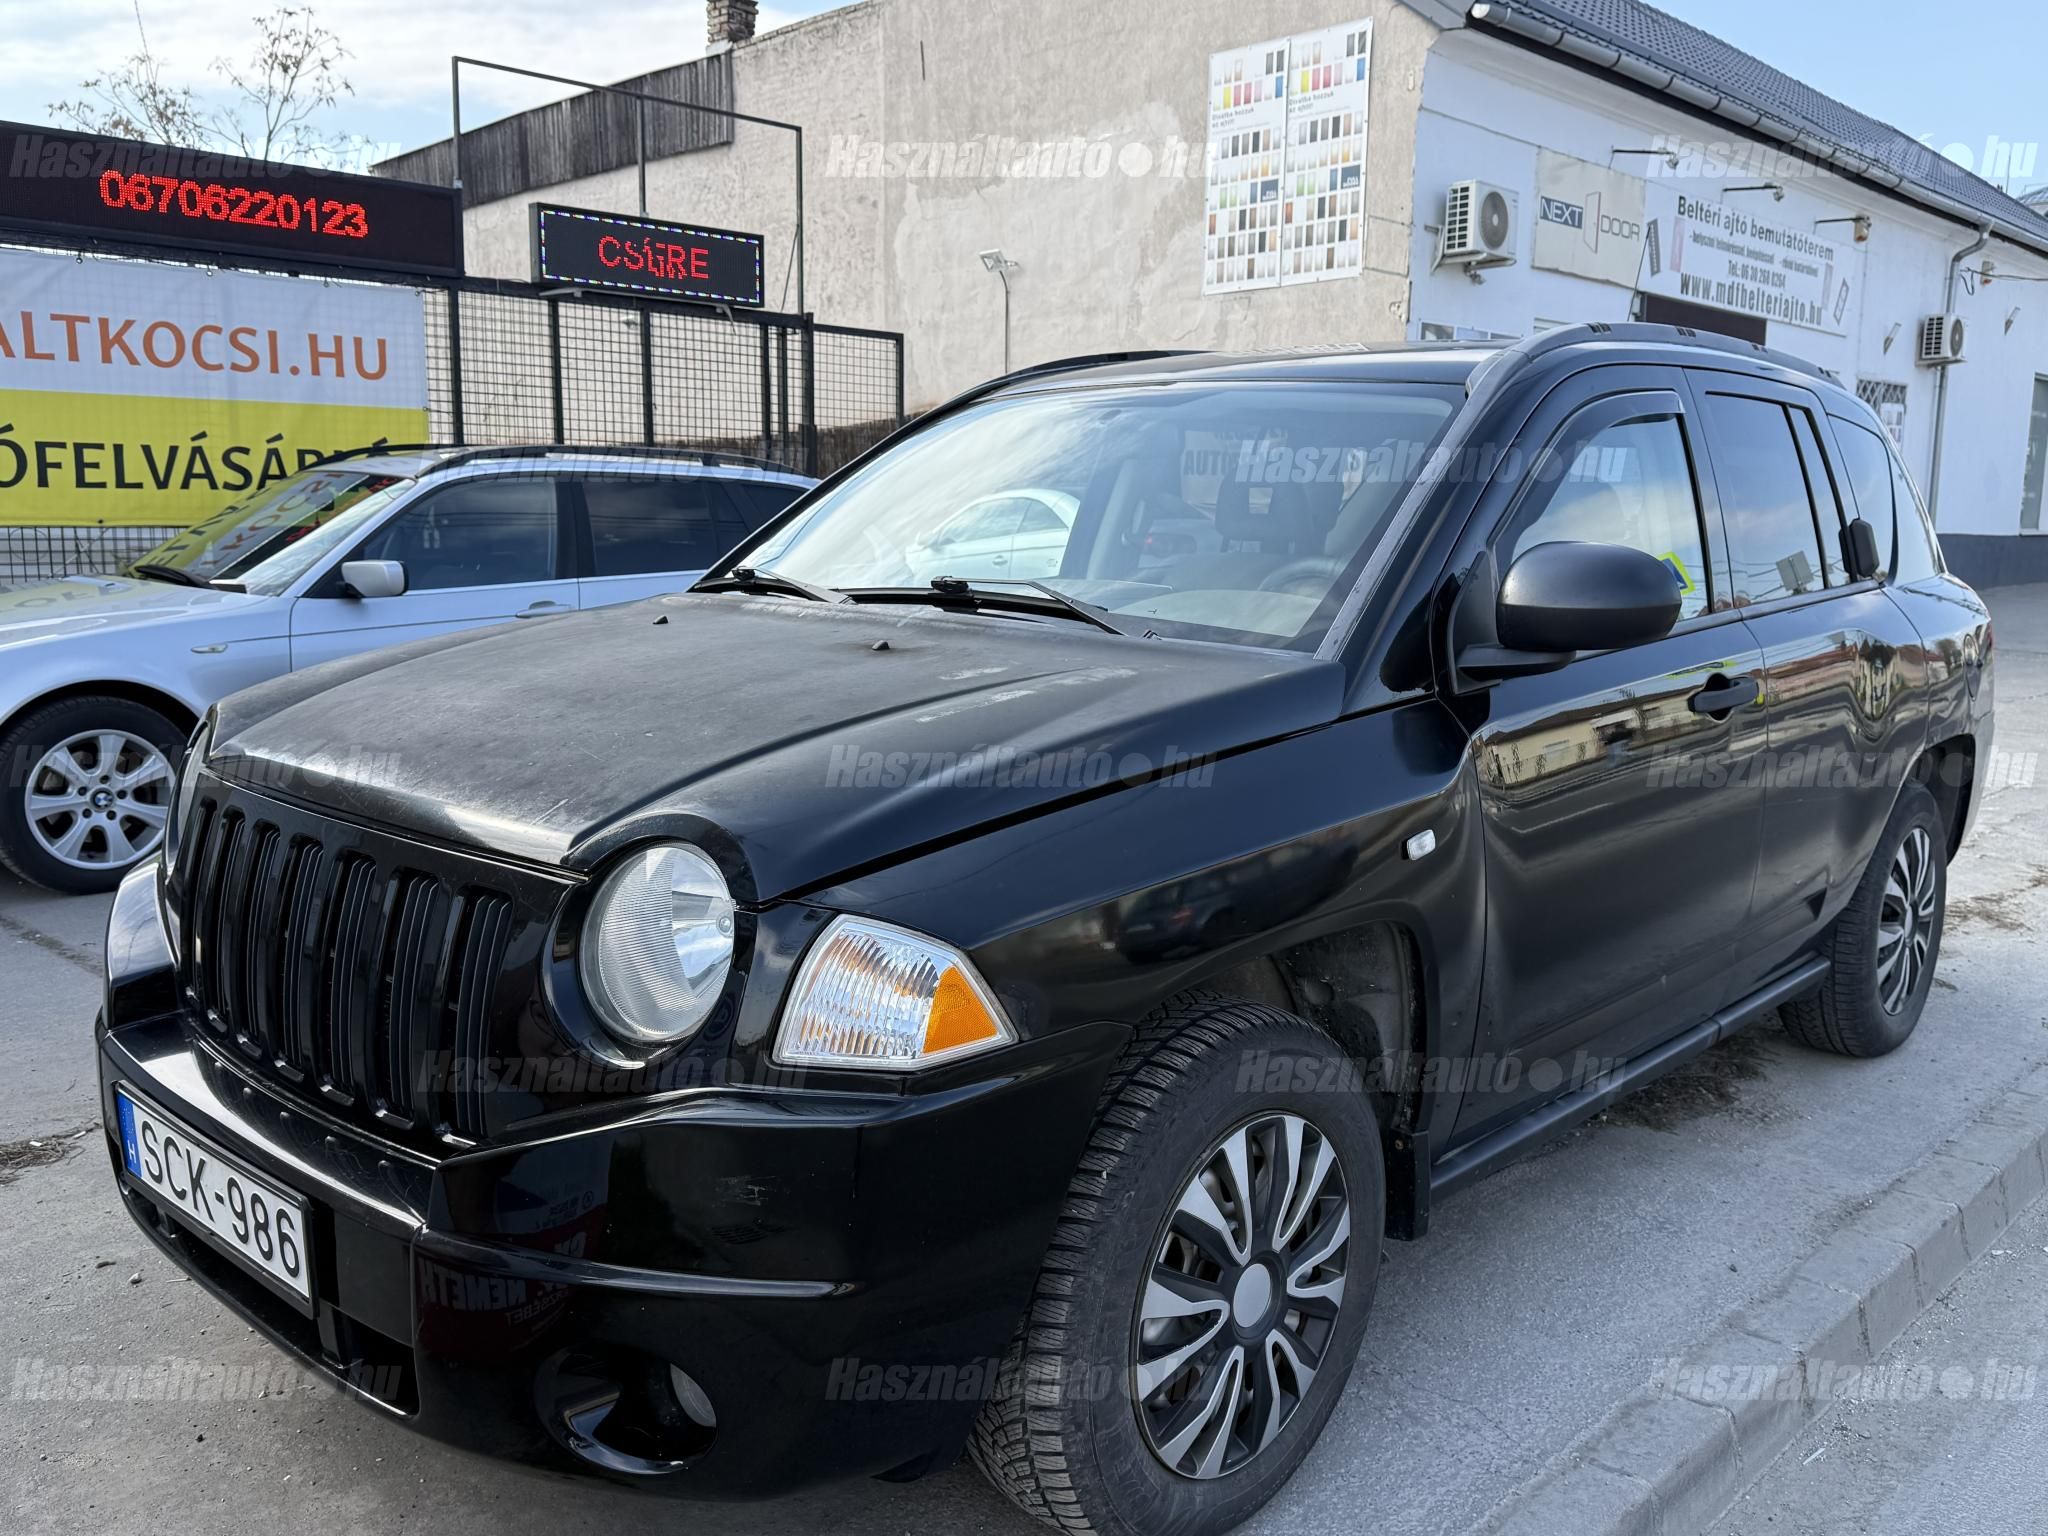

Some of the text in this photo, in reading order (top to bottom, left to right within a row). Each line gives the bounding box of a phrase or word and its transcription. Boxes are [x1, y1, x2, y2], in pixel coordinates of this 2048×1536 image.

[100, 169, 368, 238] 06706220123
[1540, 197, 1583, 228] NEXT
[1600, 214, 1640, 241] DOOR
[1678, 196, 1721, 226] Beltéri
[1724, 209, 1748, 236] ajtó
[1751, 217, 1834, 261] bemutatóterem
[1681, 272, 1823, 326] www.mdfbelteriajto.hu
[0, 423, 388, 491] ÓFELVÁSÁ
[128, 1120, 300, 1279] H SCK-986
